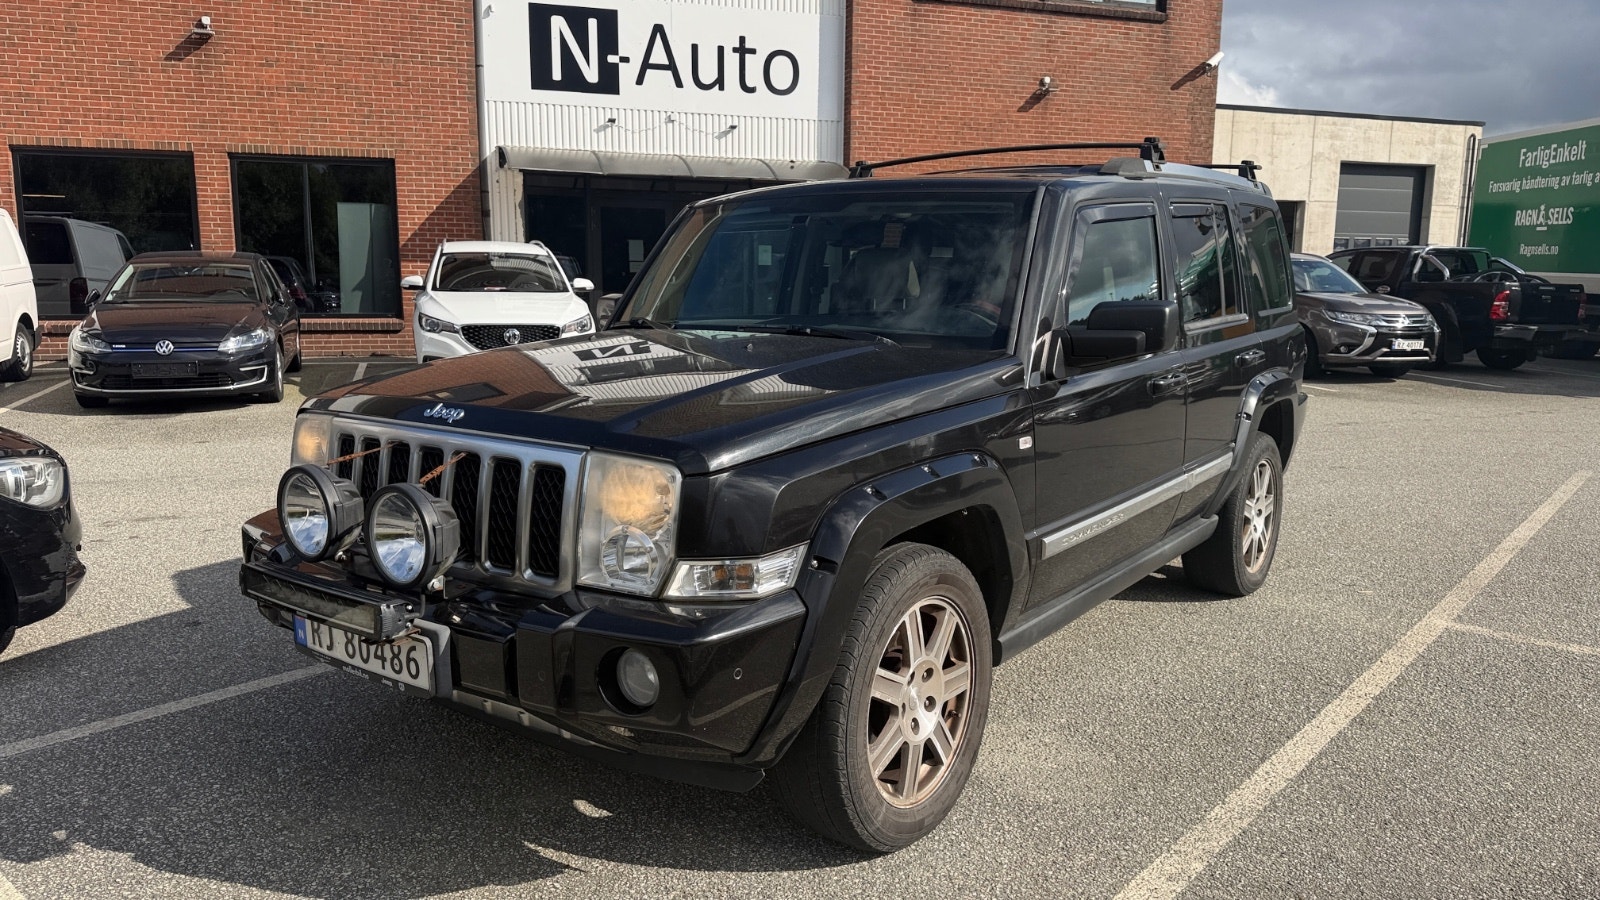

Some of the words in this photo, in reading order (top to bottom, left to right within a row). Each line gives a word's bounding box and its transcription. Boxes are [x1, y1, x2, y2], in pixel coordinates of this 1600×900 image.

[550, 14, 800, 96] N-Auto
[1519, 140, 1587, 168] FarligEnkelt
[1488, 178, 1521, 193] Forsvarlig
[1521, 174, 1560, 190] håndtering
[1561, 174, 1571, 186] av
[1571, 170, 1594, 187] farlig
[1595, 172, 1600, 183] a
[1548, 206, 1574, 225] SELLS
[1519, 243, 1559, 257] Ragnsells.no
[423, 402, 465, 424] Jeep
[311, 620, 334, 651] RJ
[344, 630, 420, 680] 80486
